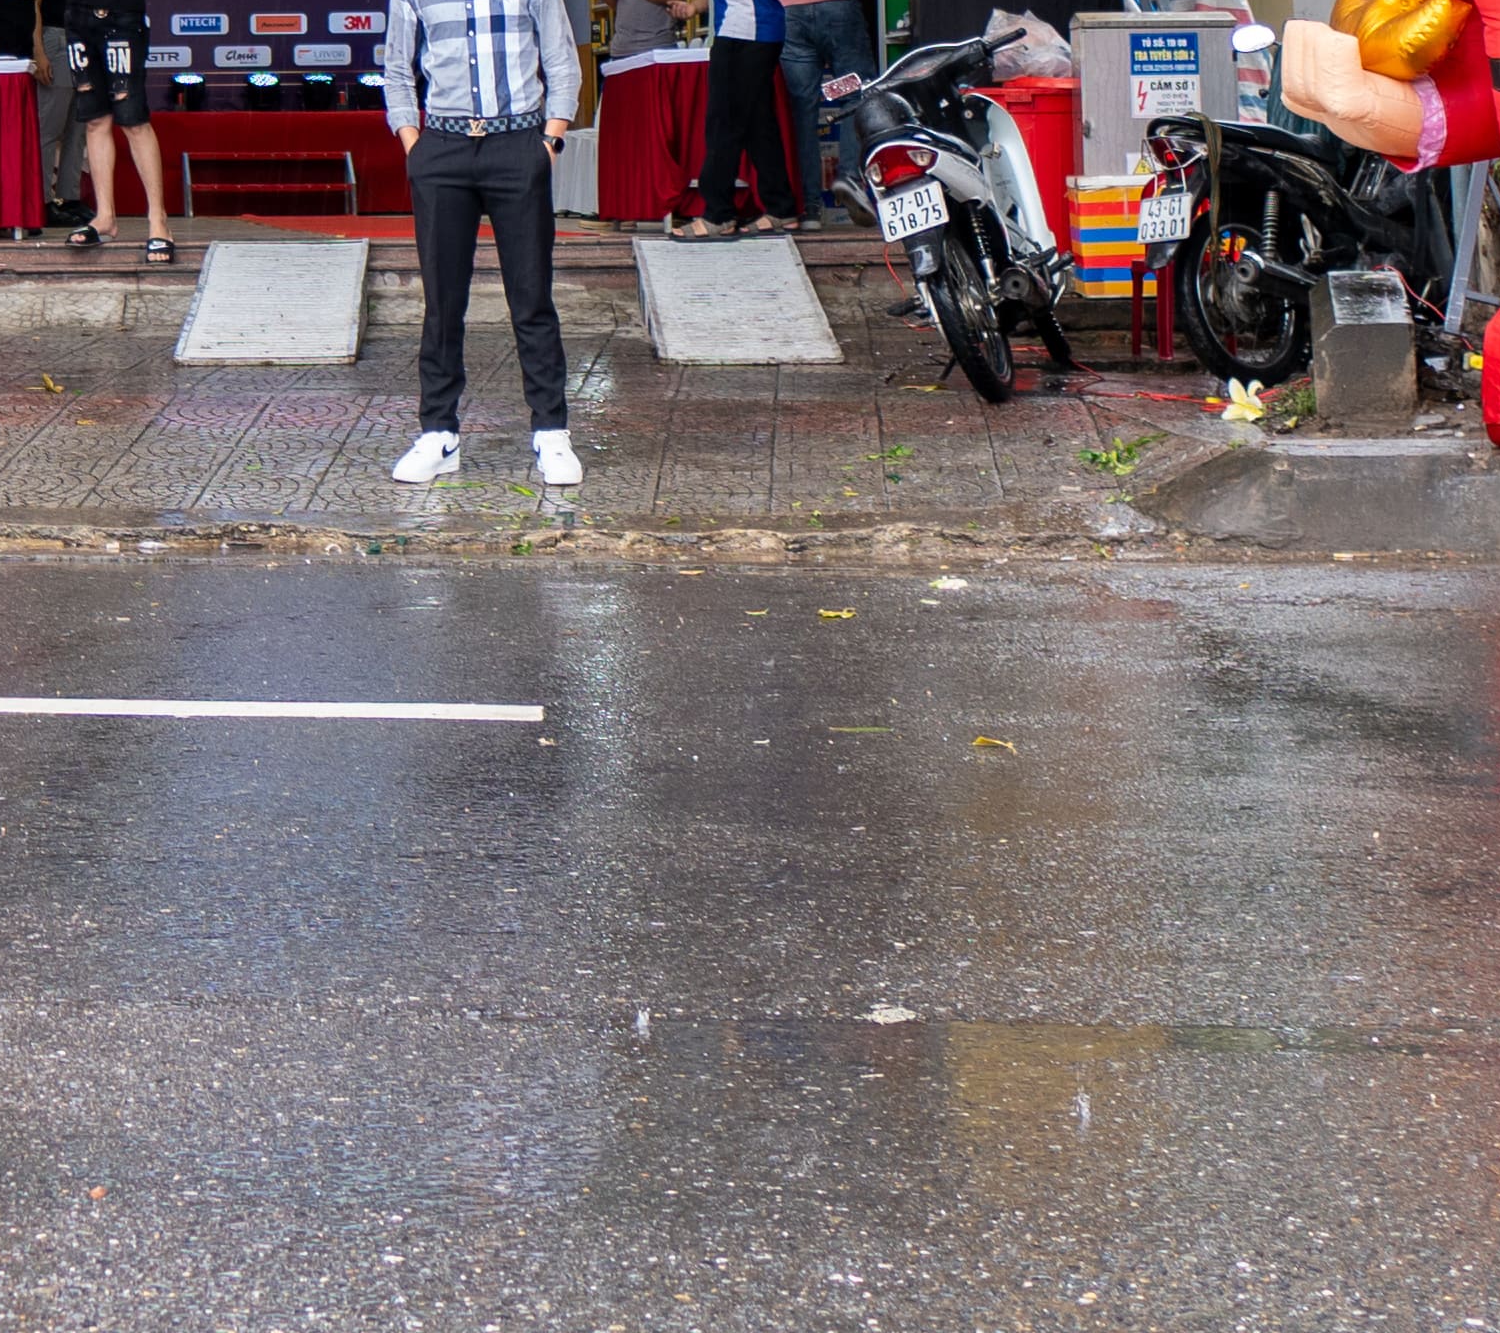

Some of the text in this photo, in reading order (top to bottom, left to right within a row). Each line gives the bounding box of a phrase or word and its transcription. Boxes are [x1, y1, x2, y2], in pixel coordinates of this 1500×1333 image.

[344, 15, 371, 30] 3M
[888, 188, 933, 218] 37-D1
[1147, 196, 1184, 218] 43-G1
[887, 205, 943, 238] 618.75
[1140, 218, 1187, 241] 033.01
